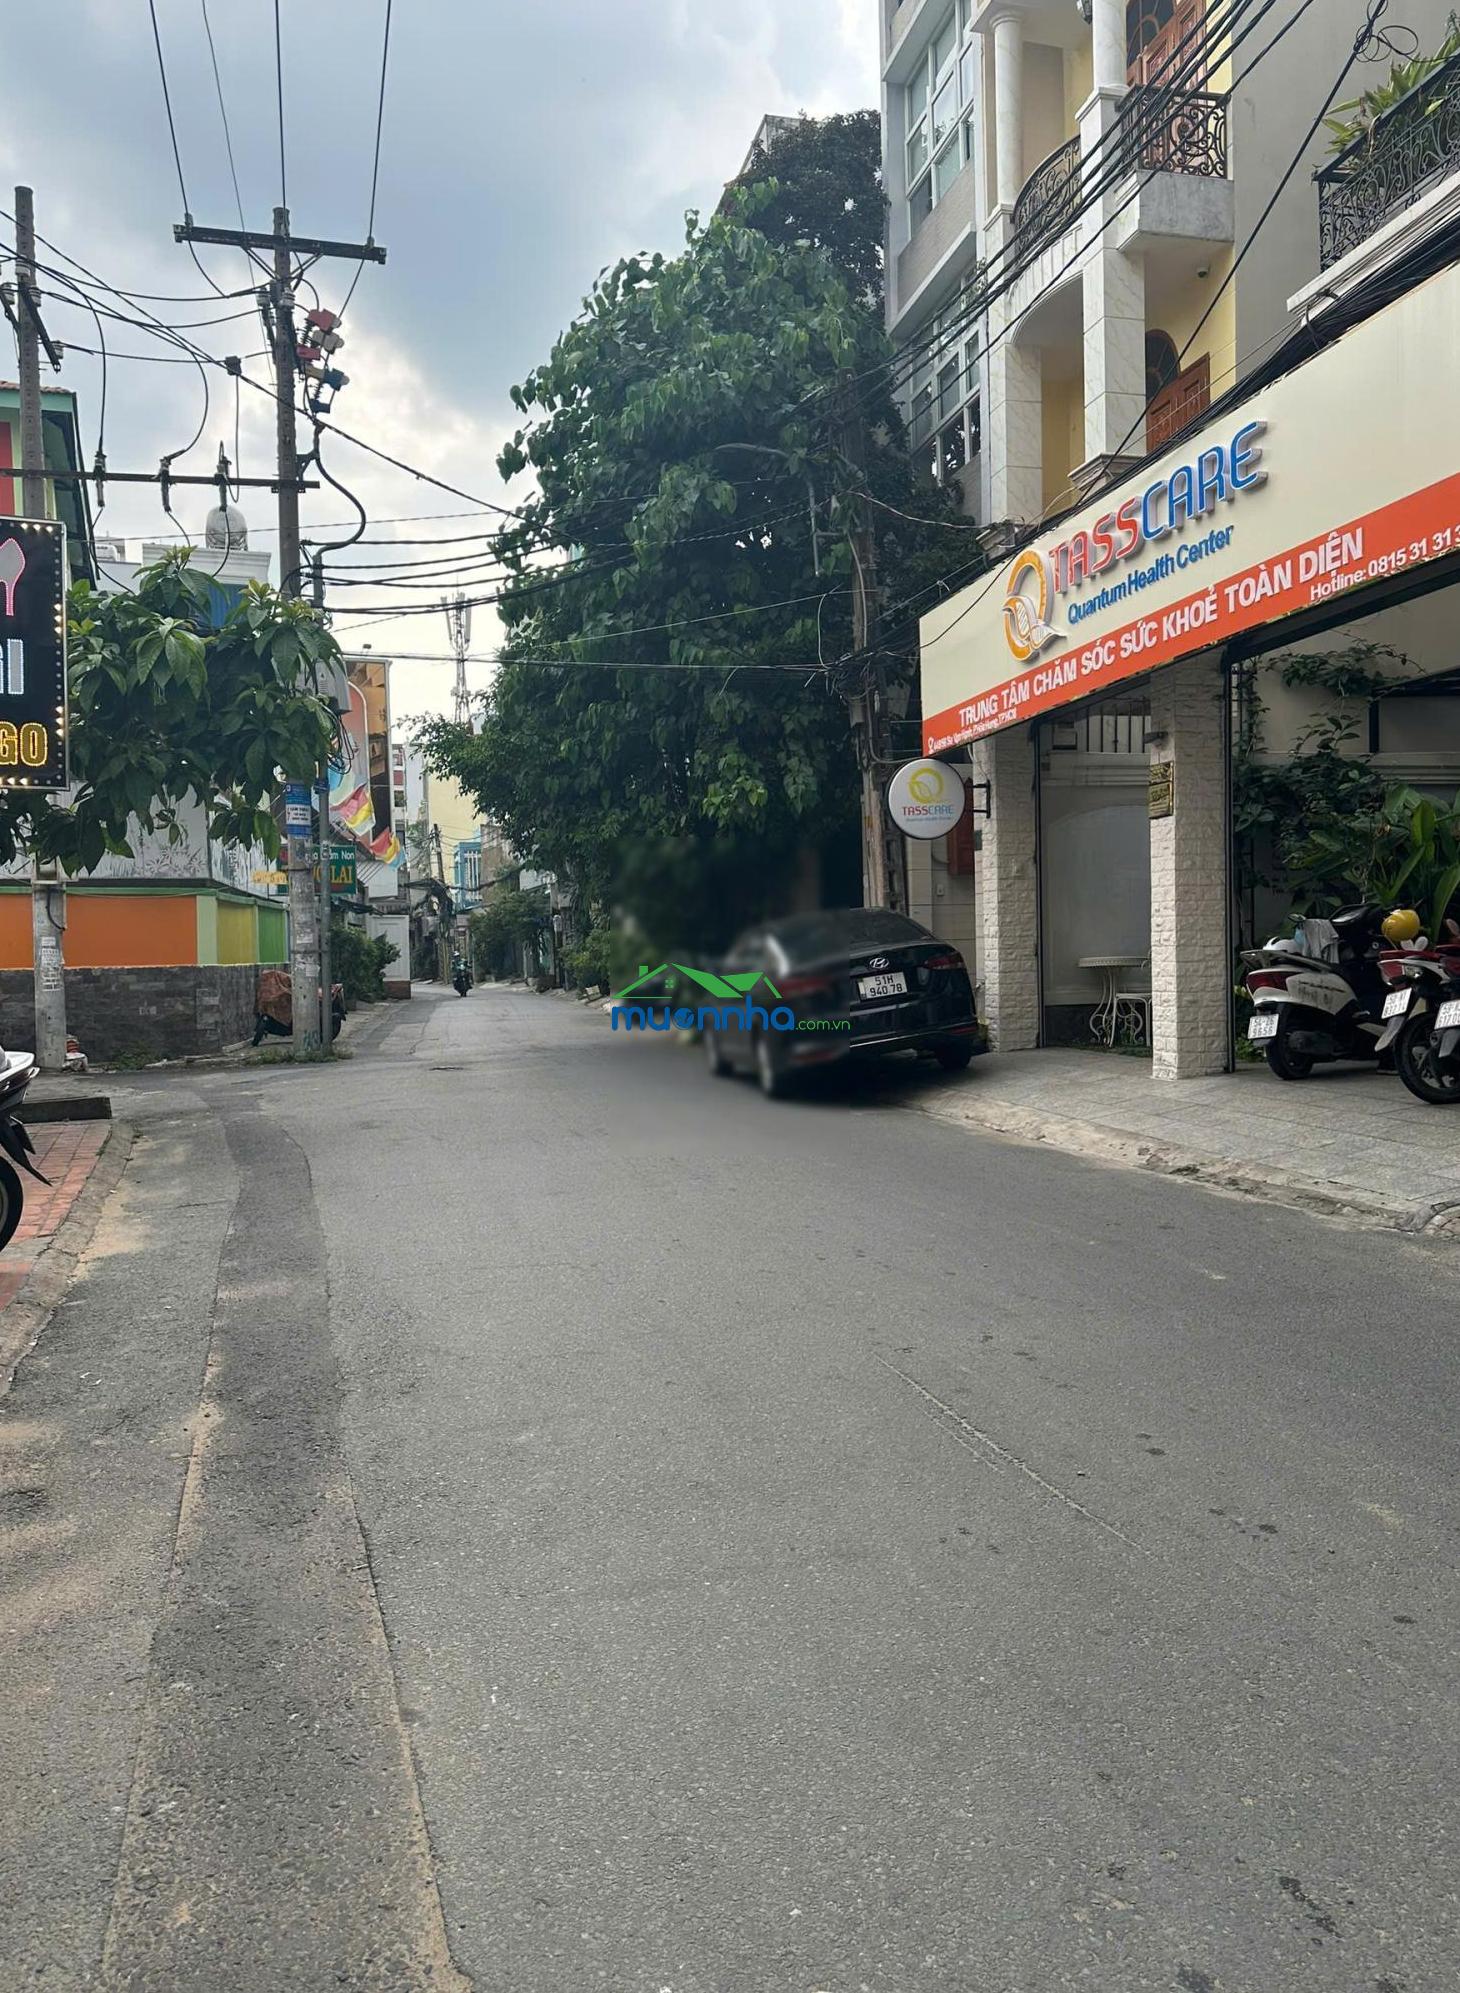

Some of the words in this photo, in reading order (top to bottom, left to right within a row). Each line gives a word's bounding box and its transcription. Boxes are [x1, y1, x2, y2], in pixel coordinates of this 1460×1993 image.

[1049, 420, 1265, 594] TASSCARE
[1068, 578, 1128, 625] Quantum
[1127, 553, 1176, 596] Health
[1176, 525, 1235, 570] Center
[1310, 568, 1367, 601] Hotline:
[1368, 551, 1407, 577] 0815
[1408, 537, 1427, 561] 31
[1432, 527, 1451, 551] 31
[0, 638, 24, 695] I
[958, 694, 999, 728] TRUNG
[1001, 680, 1030, 710] TÂM
[1033, 660, 1078, 697] CHĂM
[1081, 639, 1116, 676] SÓC
[1120, 619, 1159, 660] SỨC
[1162, 584, 1218, 642] KHOẺ
[1224, 562, 1293, 614] TOÀN
[1299, 527, 1364, 584] DIỆN
